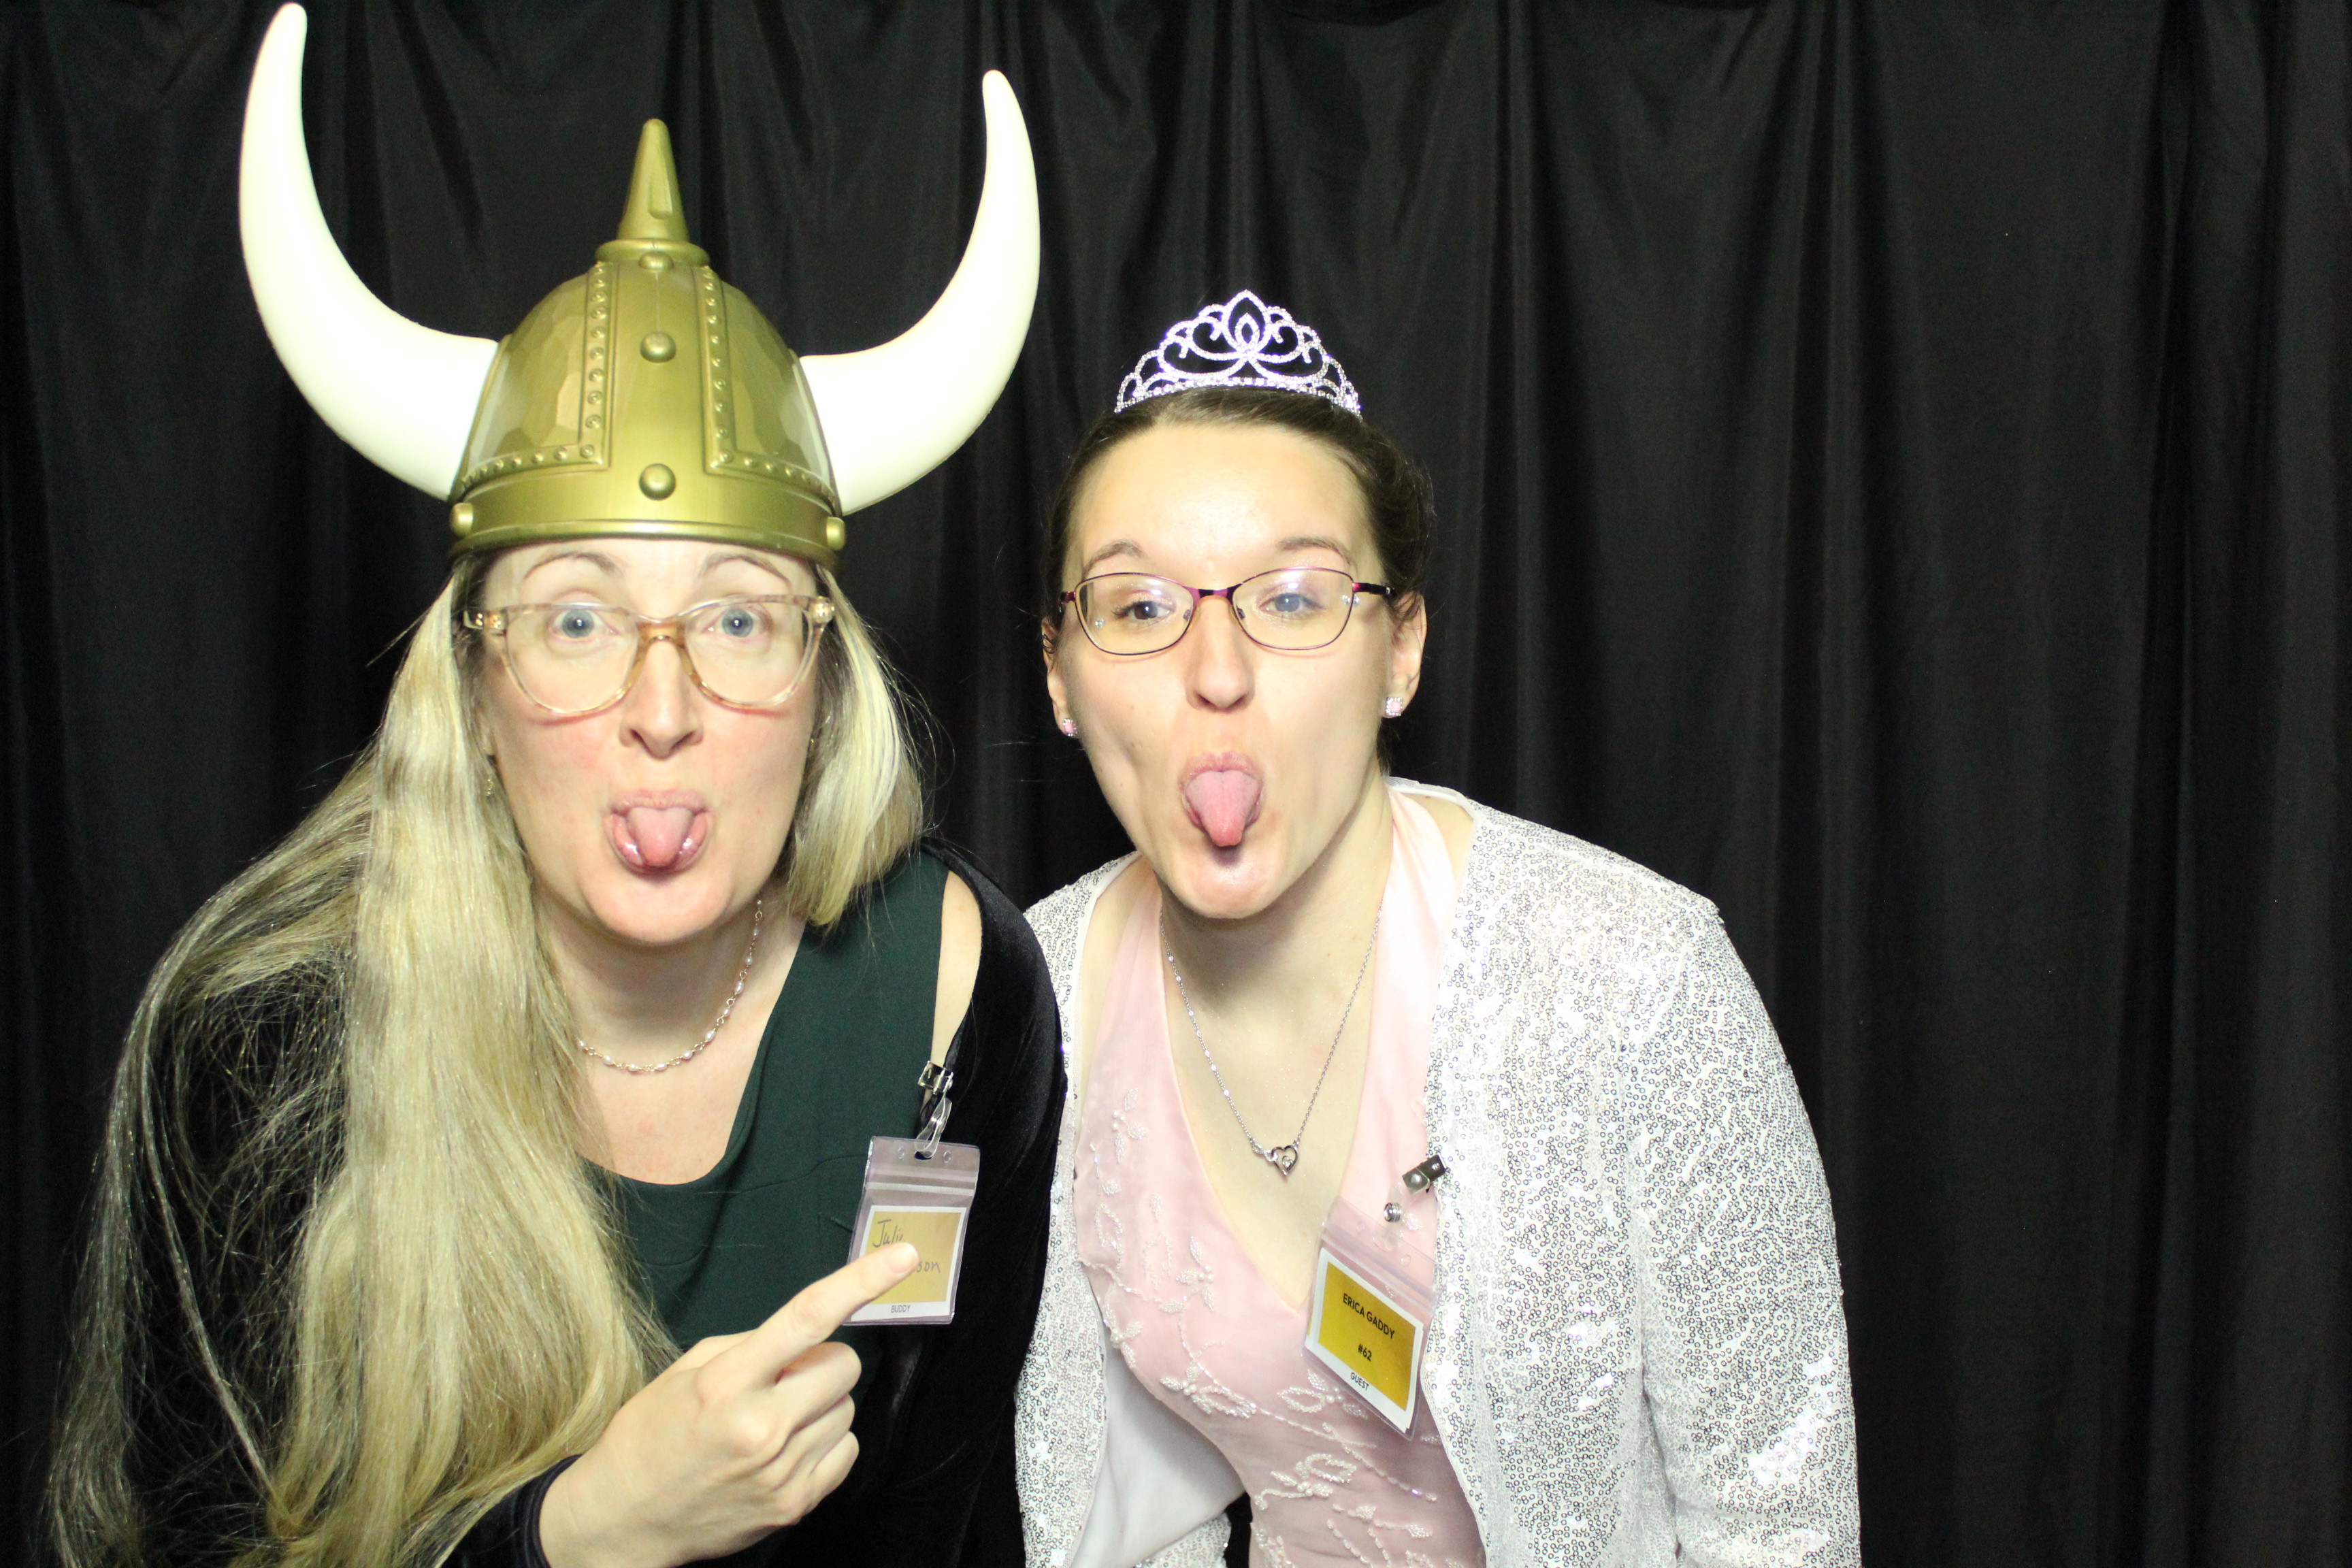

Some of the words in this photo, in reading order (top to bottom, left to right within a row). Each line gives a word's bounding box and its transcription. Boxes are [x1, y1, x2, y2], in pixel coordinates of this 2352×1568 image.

[891, 1305, 911, 1313] BUDDY
[1343, 1293, 1365, 1318] ERICA
[1367, 1311, 1394, 1339] GADDY
[1358, 1343, 1372, 1362] #62
[1350, 1372, 1369, 1390] GUEST
